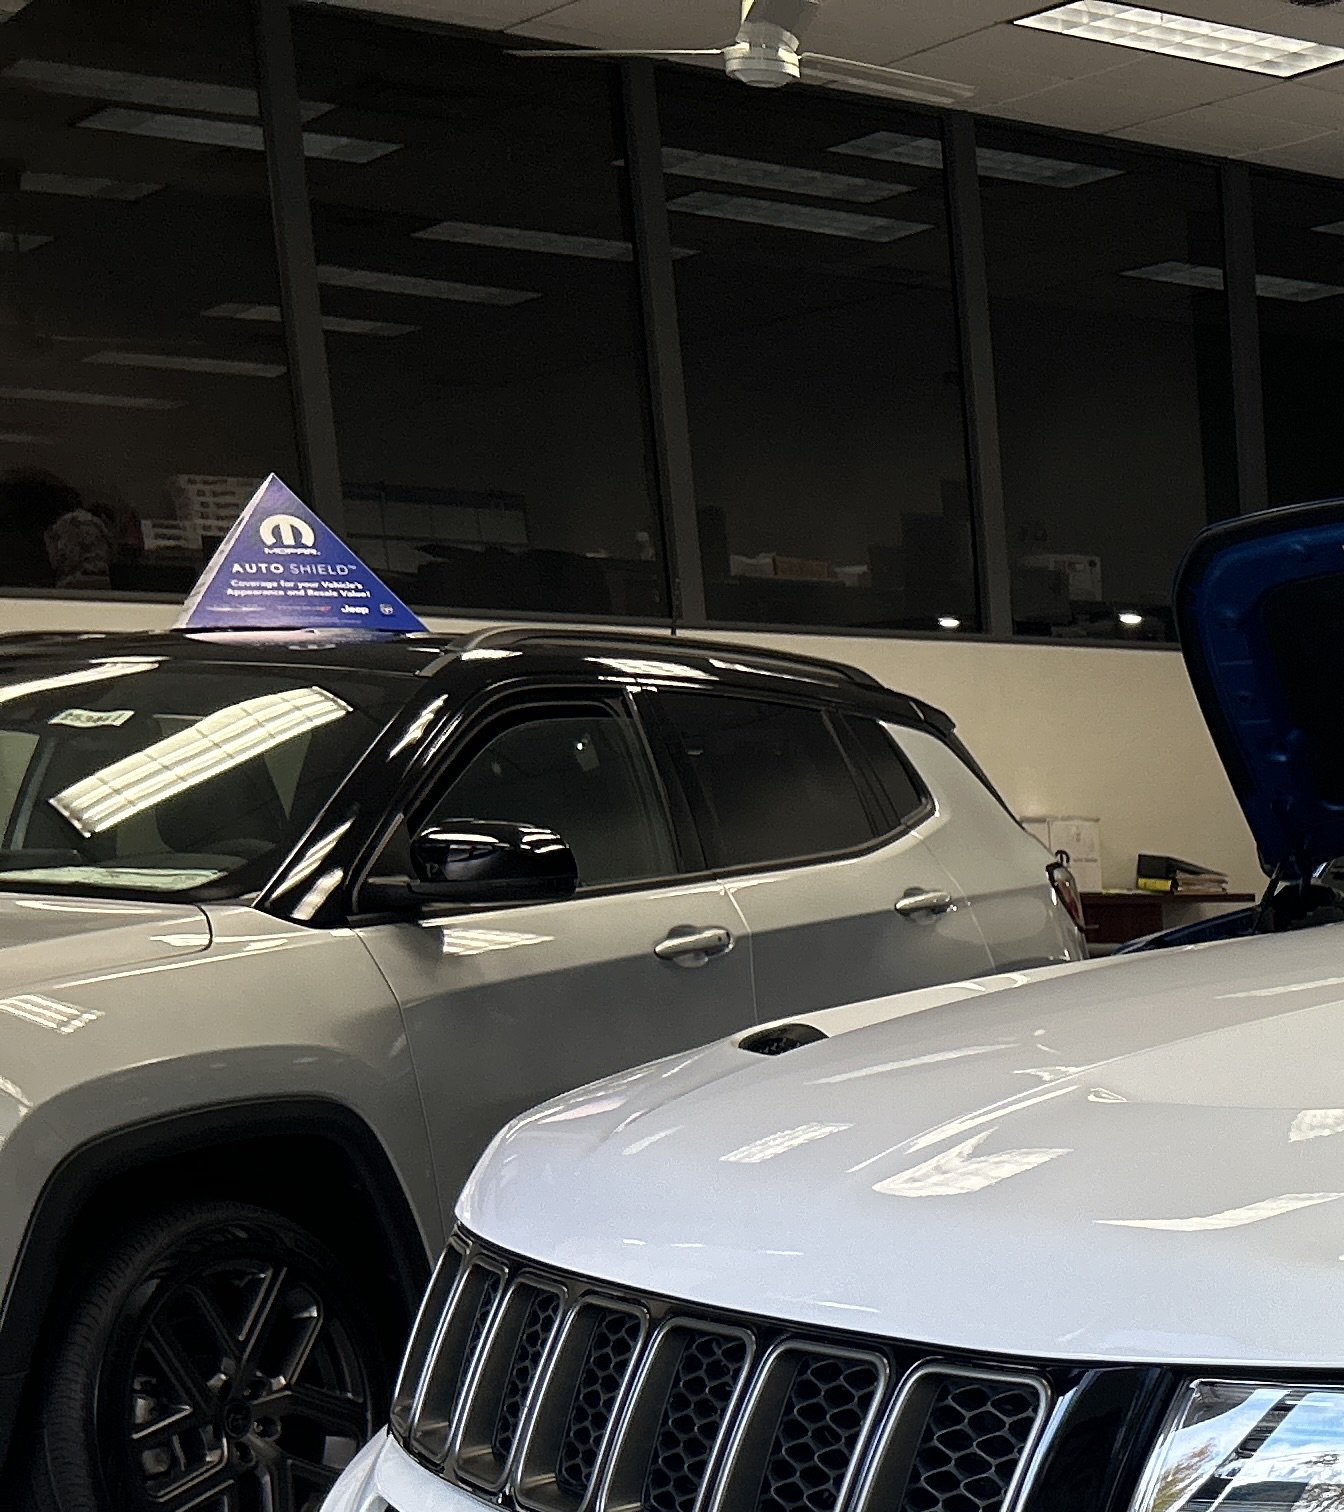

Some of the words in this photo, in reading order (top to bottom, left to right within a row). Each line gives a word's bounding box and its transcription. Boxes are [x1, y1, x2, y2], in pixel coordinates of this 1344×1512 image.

[232, 563, 284, 574] AUTO
[230, 580, 278, 588] Coverage
[280, 580, 295, 588] for
[321, 581, 363, 590] Vehicle's
[226, 588, 284, 596] Appearance
[340, 604, 369, 614] Jeep
